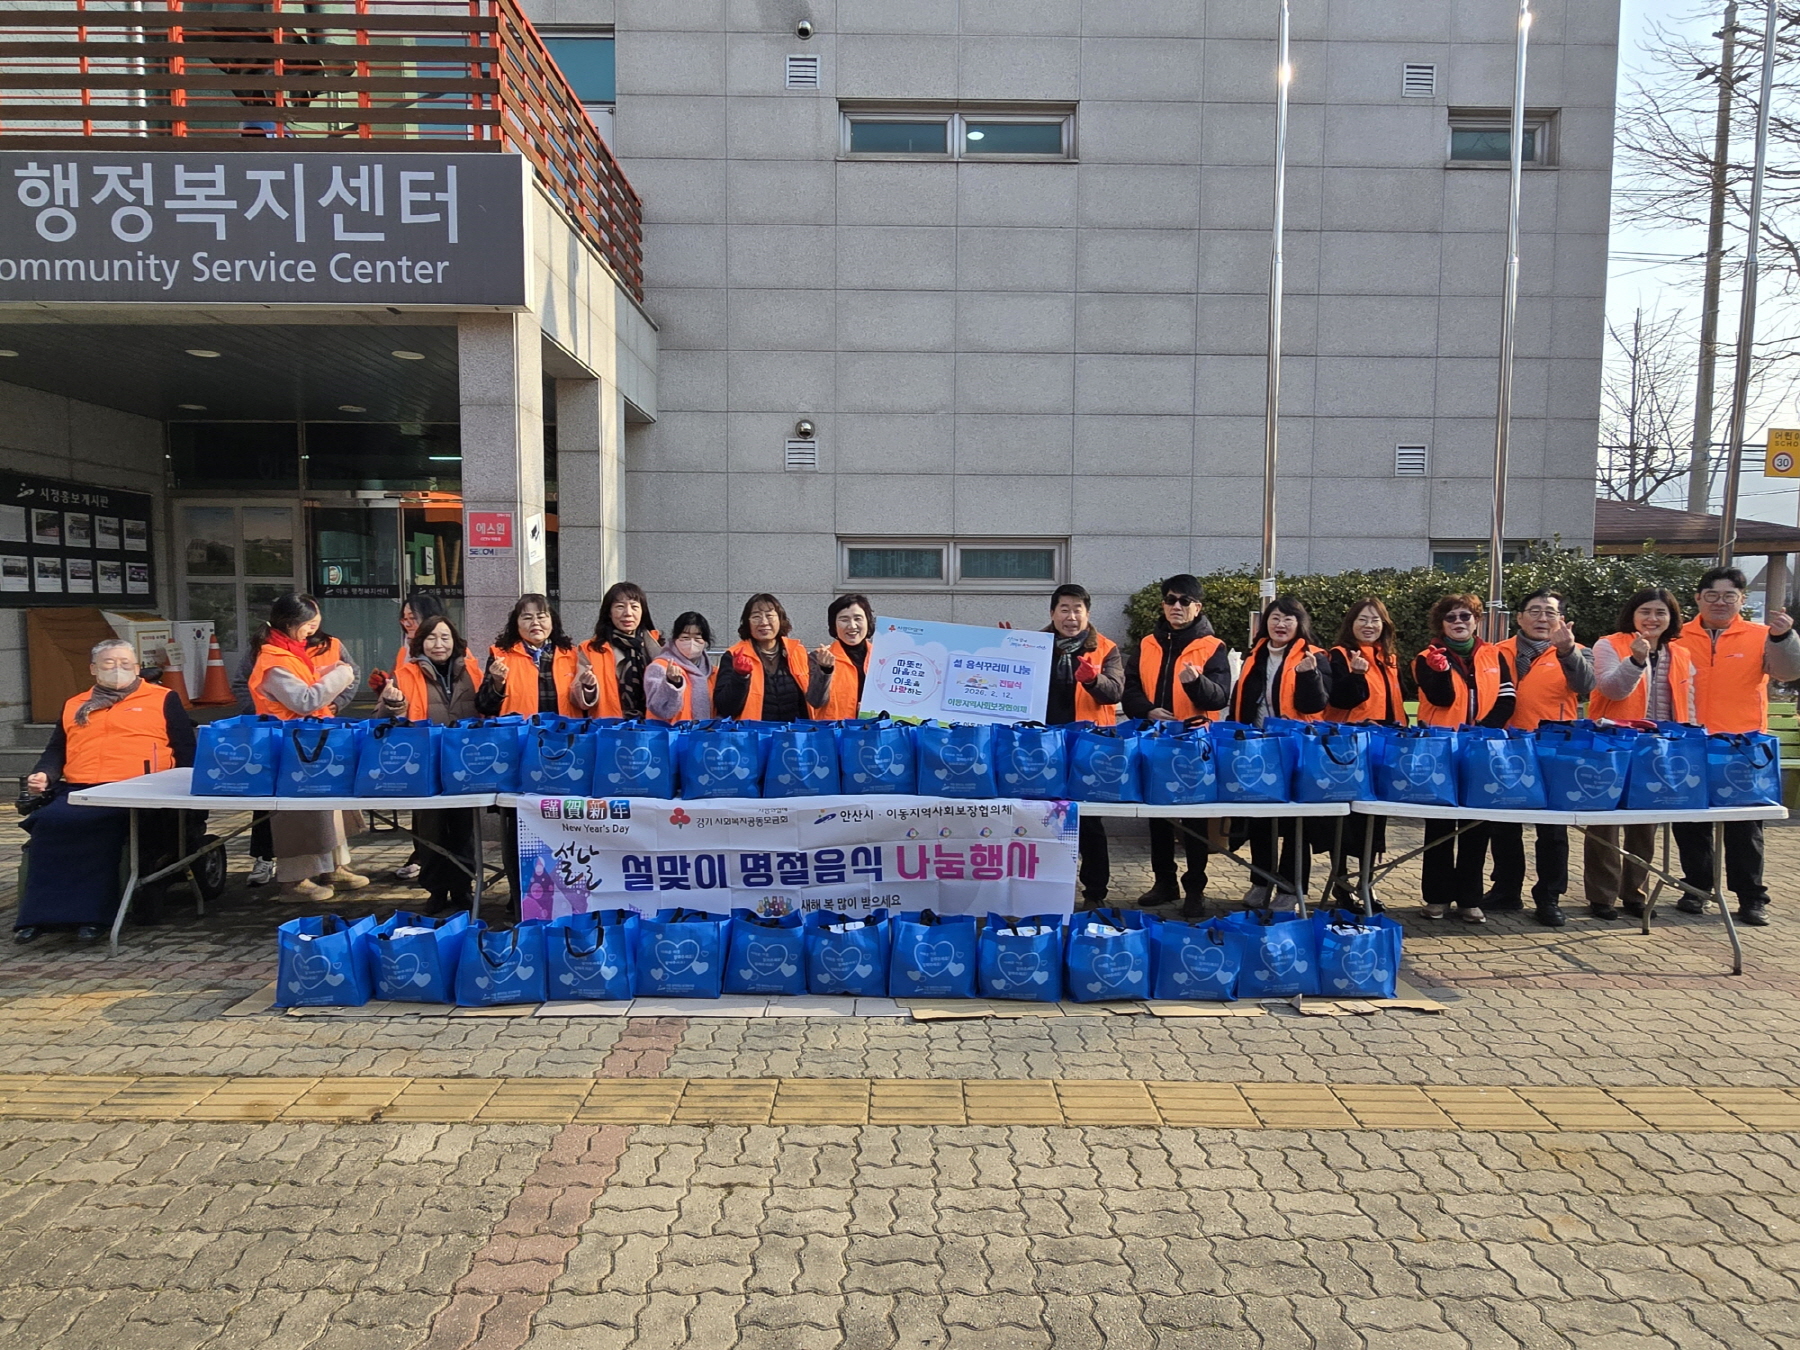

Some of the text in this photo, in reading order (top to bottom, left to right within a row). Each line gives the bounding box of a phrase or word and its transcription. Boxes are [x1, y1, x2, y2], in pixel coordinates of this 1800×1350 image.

[14, 162, 459, 244] 행정복지센터
[192, 252, 317, 284] Service
[328, 253, 450, 284] Center
[1776, 458, 1790, 468] 30
[39, 487, 109, 509] 시정홍보게시판
[475, 522, 505, 535] 에스원
[351, 587, 389, 596] 행정복지센터
[897, 659, 923, 669] 따뜻한
[953, 659, 1031, 675] 설 음식꾸러미 나눔
[892, 666, 925, 677] 마음으로
[893, 677, 920, 687] 이웃을
[889, 685, 922, 696] 사랑하는
[542, 800, 629, 819] 謹賀新年
[839, 810, 875, 823] 안산시
[886, 804, 1013, 821] 이동지역사회보장협의체
[562, 823, 630, 834] New Year's Day
[696, 815, 713, 829] 경기
[621, 841, 1040, 892] 설맞이 명절음식 나눔행사
[801, 894, 902, 913] 새해 복 많이 받으세요
